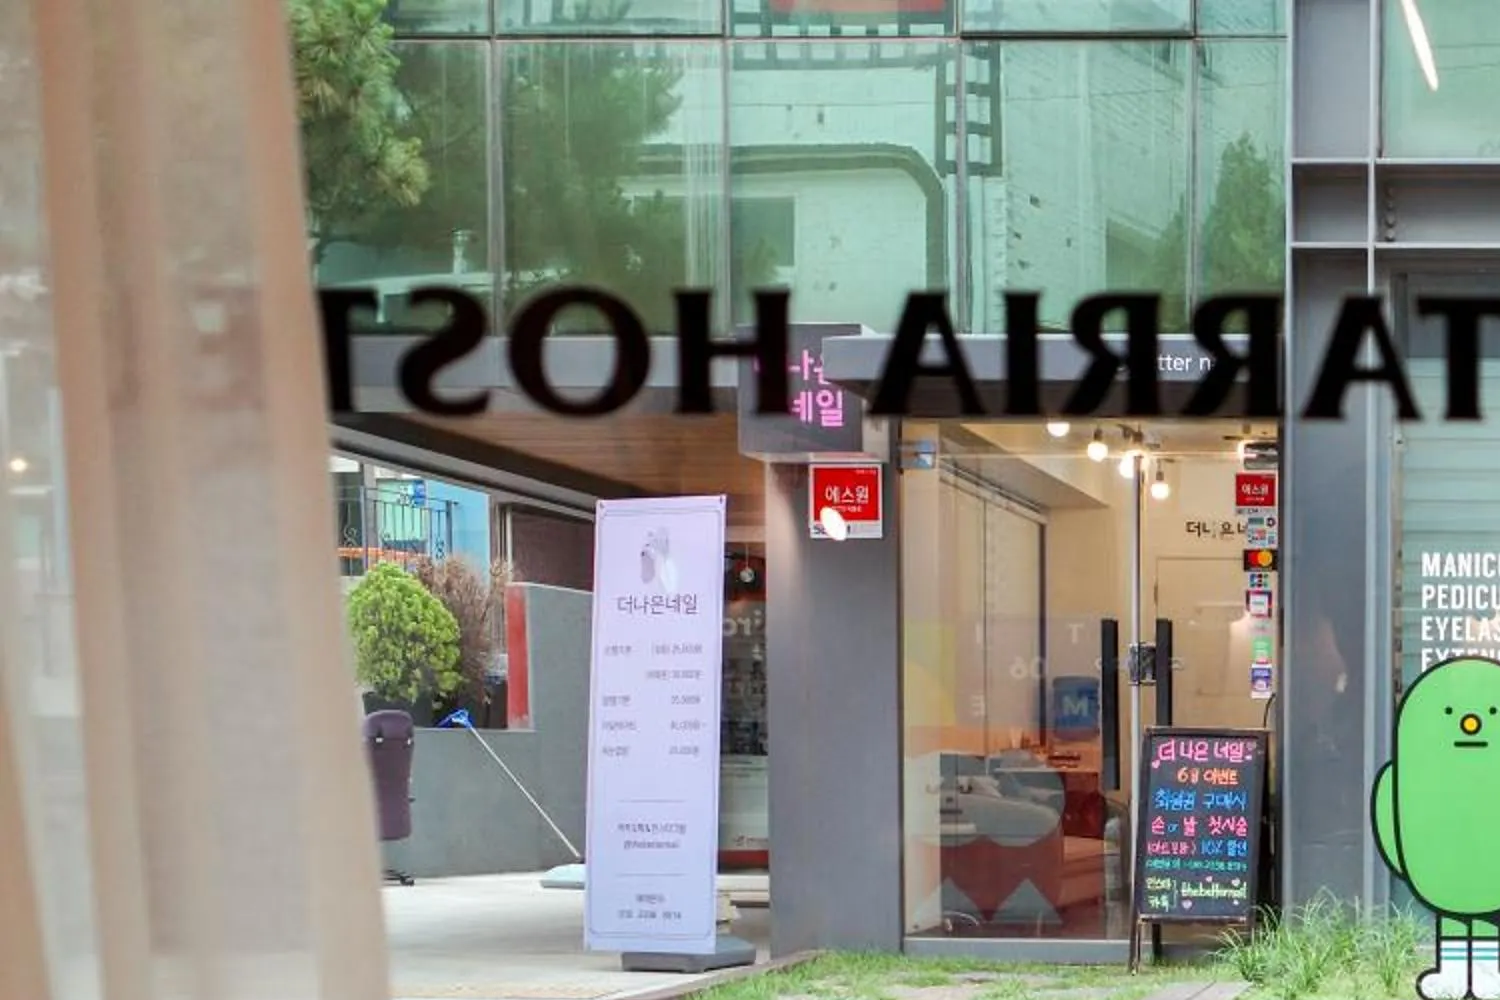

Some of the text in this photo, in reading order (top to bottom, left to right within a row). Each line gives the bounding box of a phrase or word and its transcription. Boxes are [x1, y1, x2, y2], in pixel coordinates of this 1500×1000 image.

[825, 484, 869, 505] 에스원
[617, 593, 698, 615] 더나은네일
[1158, 739, 1175, 761] 더
[1180, 740, 1209, 761] 나은
